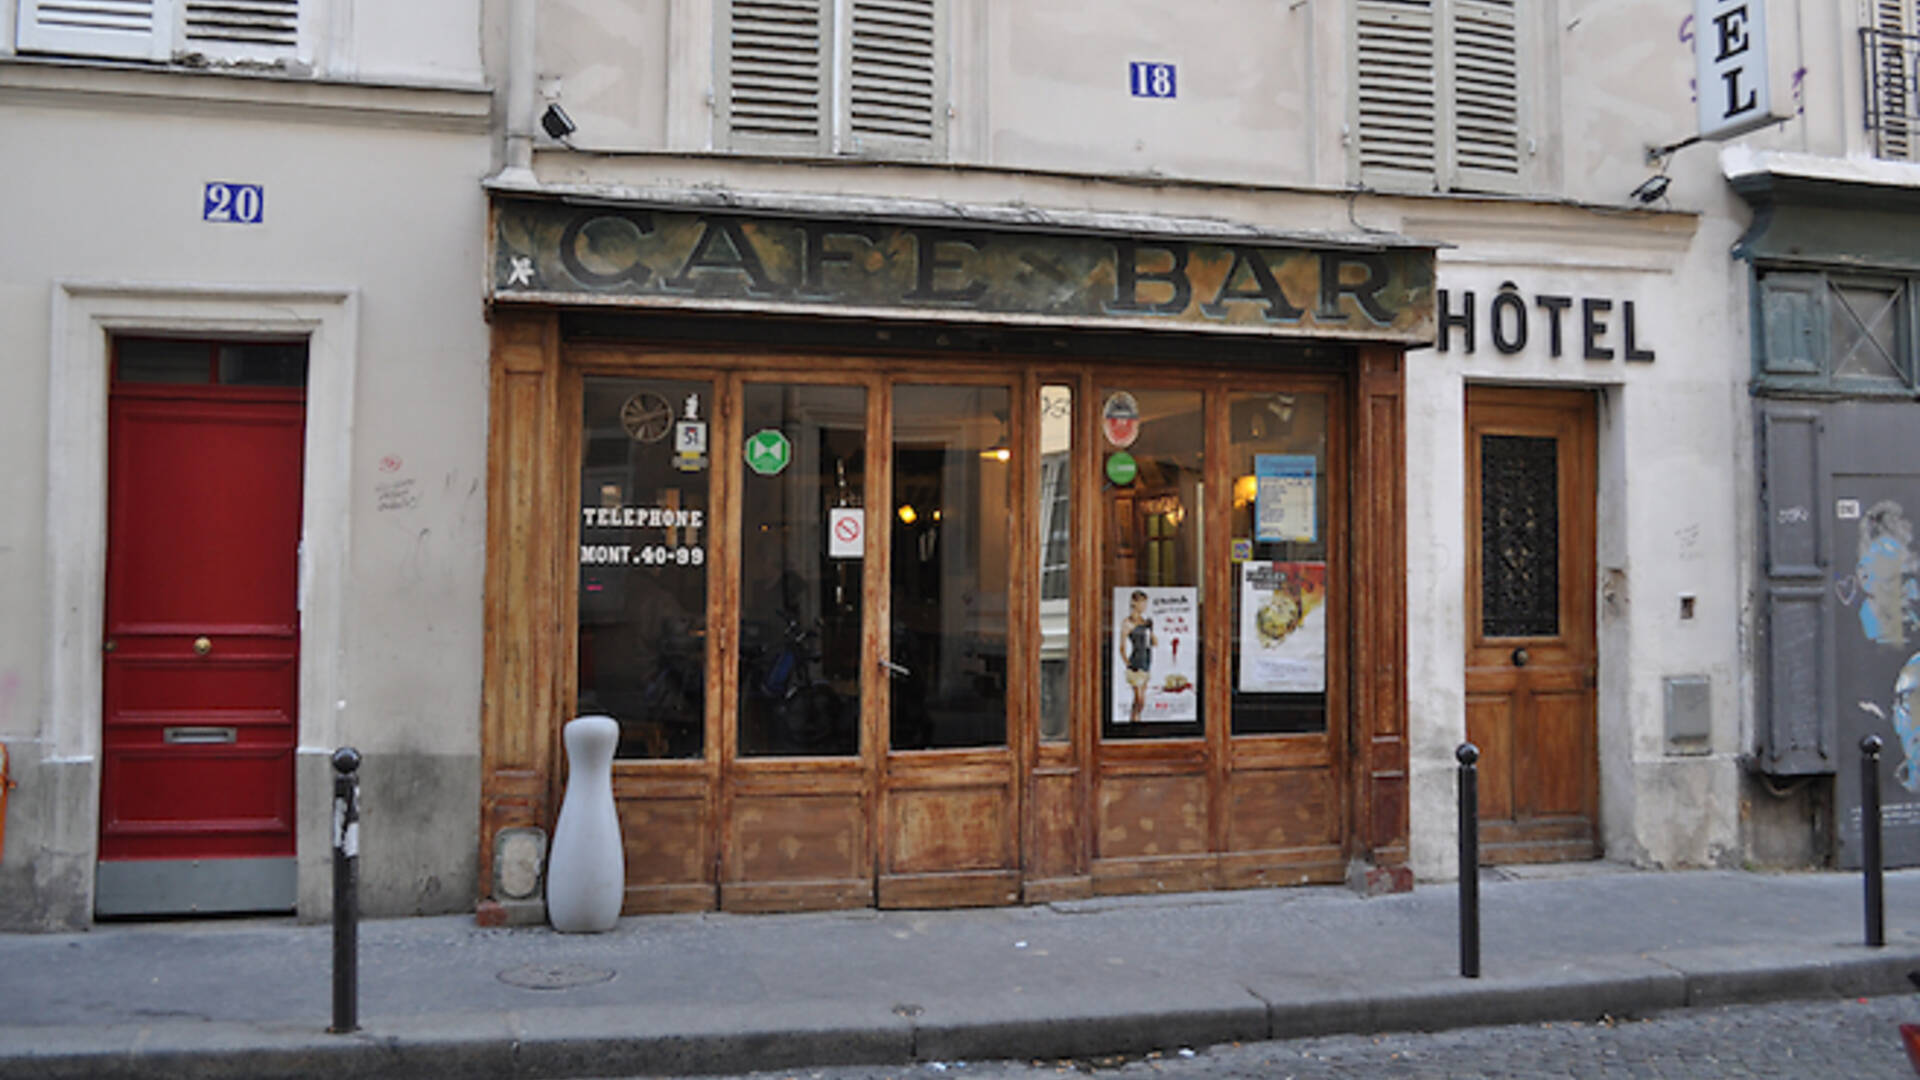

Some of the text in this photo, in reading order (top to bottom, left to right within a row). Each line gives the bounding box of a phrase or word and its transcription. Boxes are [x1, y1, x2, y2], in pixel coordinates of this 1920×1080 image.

[1138, 63, 1171, 97] 18
[1712, 0, 1756, 118] EL
[208, 184, 259, 222] 20
[560, 211, 1399, 326] CAFE BAR
[1437, 280, 1655, 363] HÔTEL
[583, 507, 703, 527] TELEPHONE
